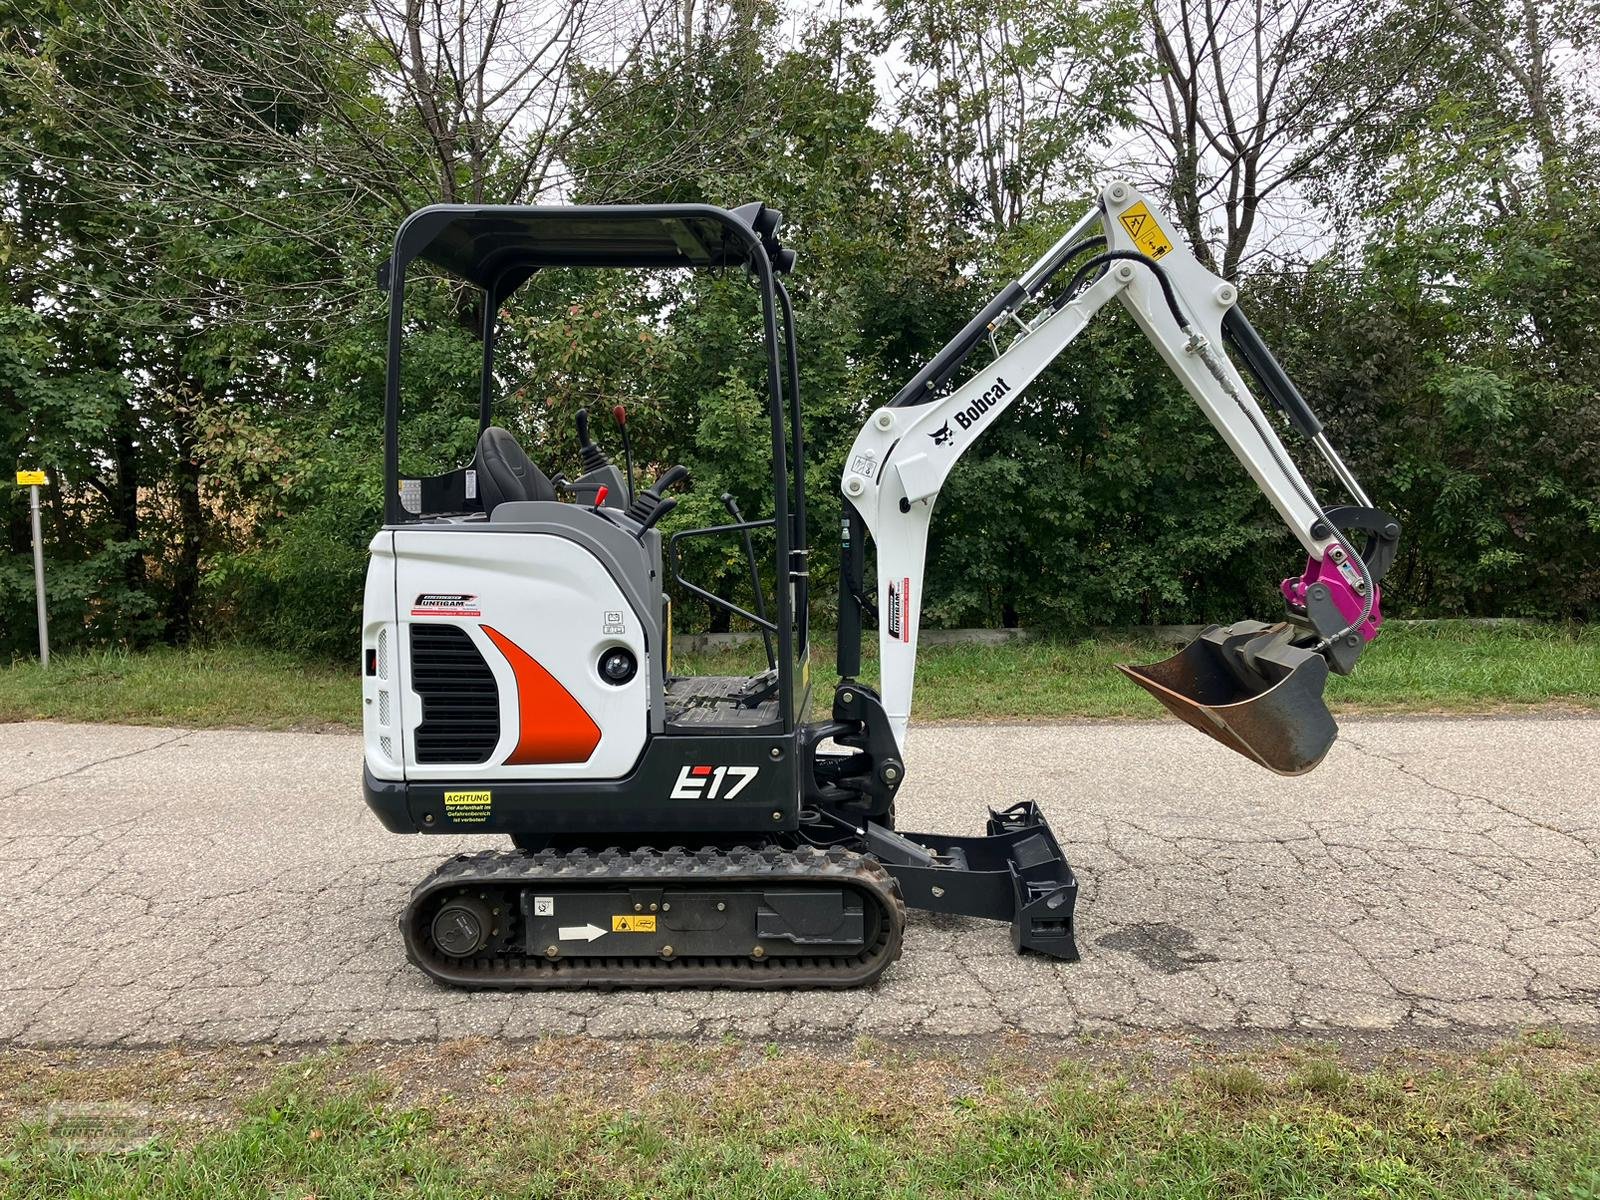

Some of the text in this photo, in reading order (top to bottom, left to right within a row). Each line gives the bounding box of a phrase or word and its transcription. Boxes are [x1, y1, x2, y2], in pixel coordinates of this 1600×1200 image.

[953, 376, 1012, 431] Bobcat
[446, 794, 489, 803] ACHTUNG
[669, 765, 760, 800] E17
